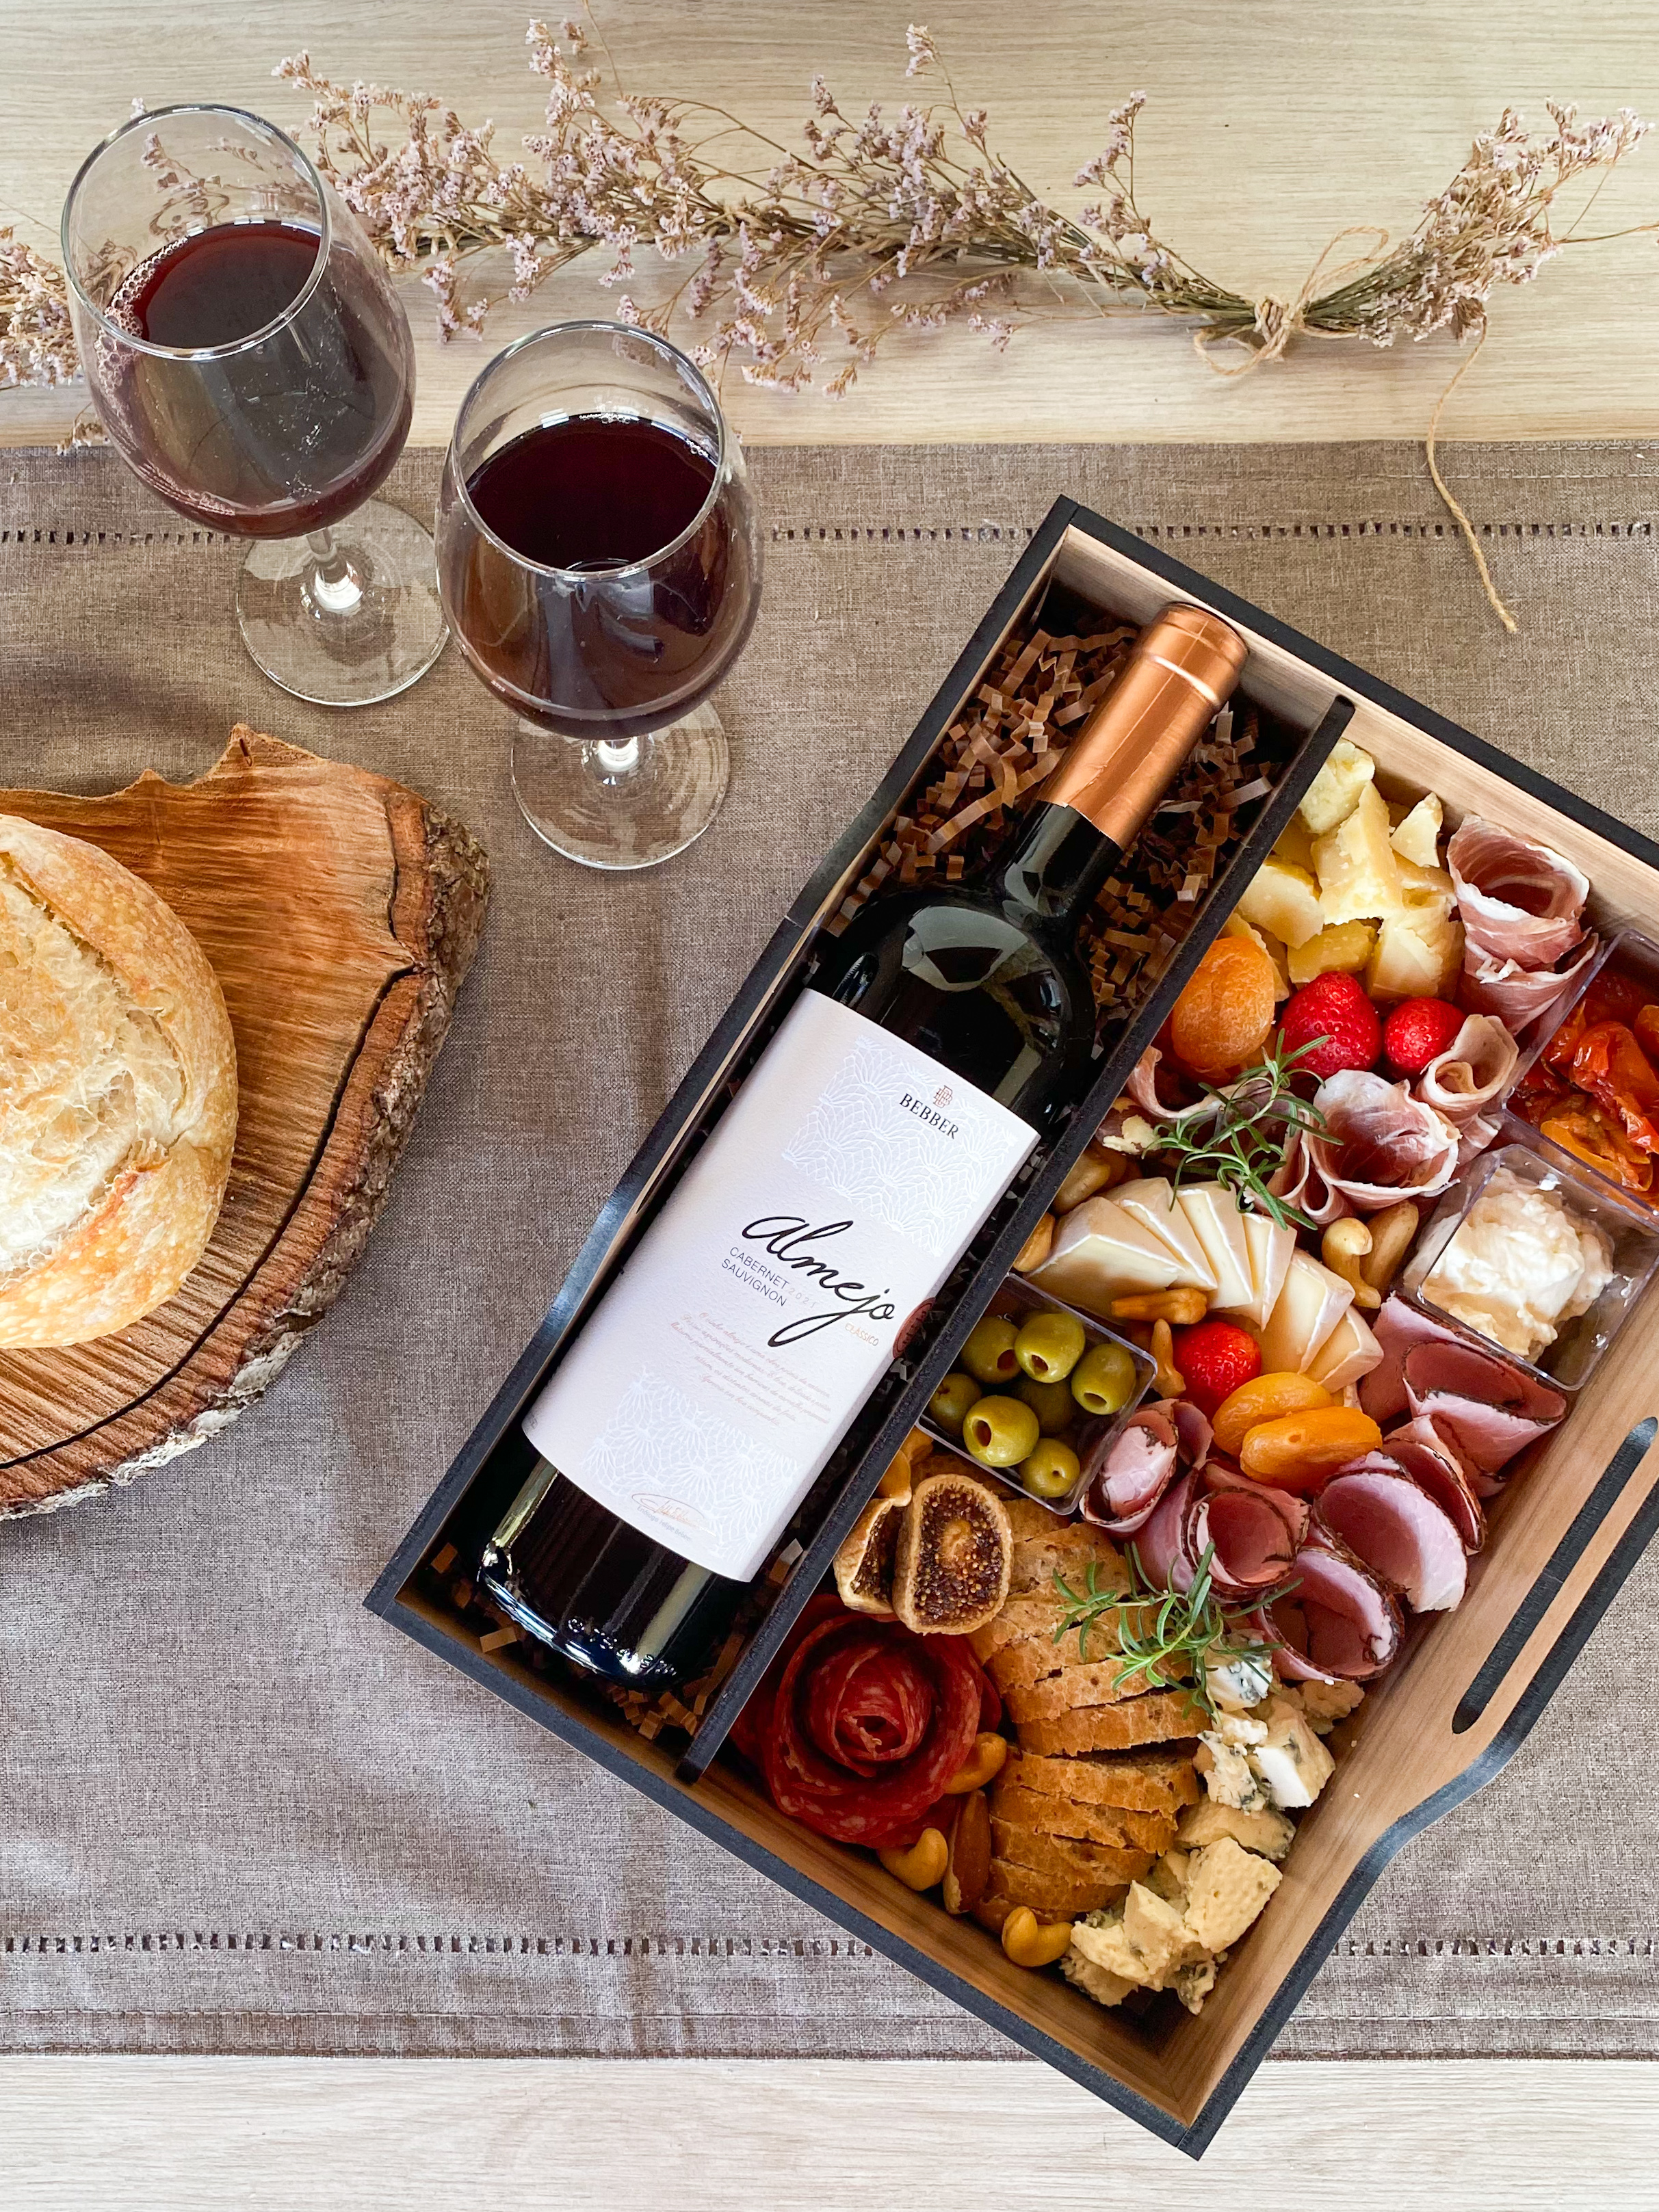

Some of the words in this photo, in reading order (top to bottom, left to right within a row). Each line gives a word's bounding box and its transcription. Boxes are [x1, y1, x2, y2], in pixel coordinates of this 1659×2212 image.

[900, 1093, 958, 1140] BEBBER
[722, 1259, 787, 1306] SAUVIGNON
[729, 1247, 790, 1289] CABERNET
[790, 1287, 819, 1308] 2021
